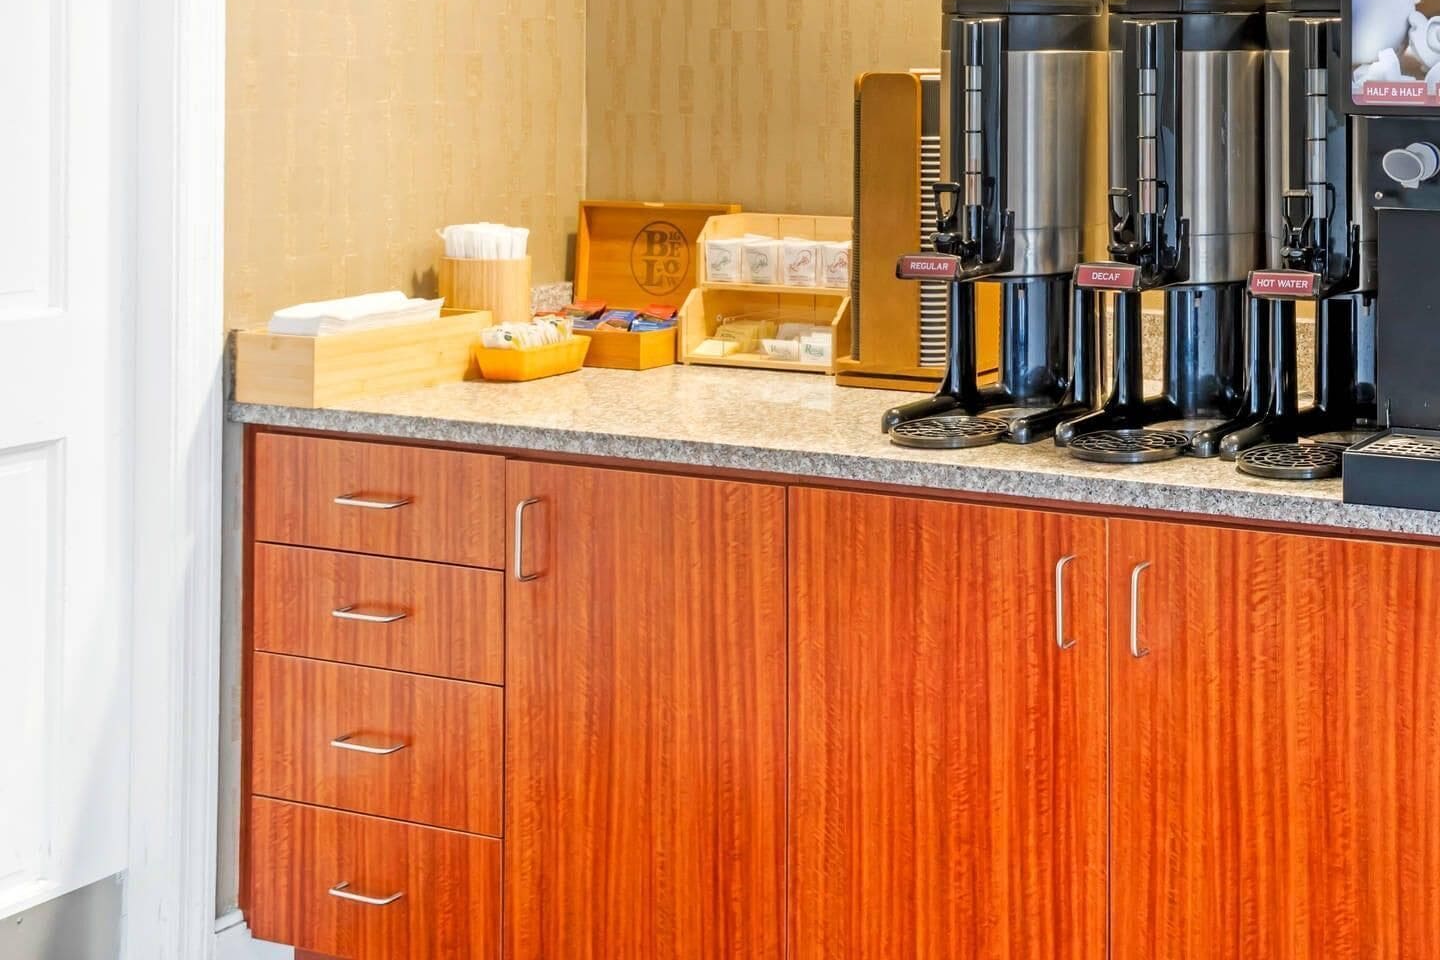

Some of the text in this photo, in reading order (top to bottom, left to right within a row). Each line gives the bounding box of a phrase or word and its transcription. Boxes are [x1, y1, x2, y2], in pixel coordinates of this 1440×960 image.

[1366, 87, 1424, 98] HALF & HALF
[910, 261, 949, 271] REGULAR
[1091, 271, 1121, 282] DECAF
[1256, 278, 1308, 289] HOT WATER
